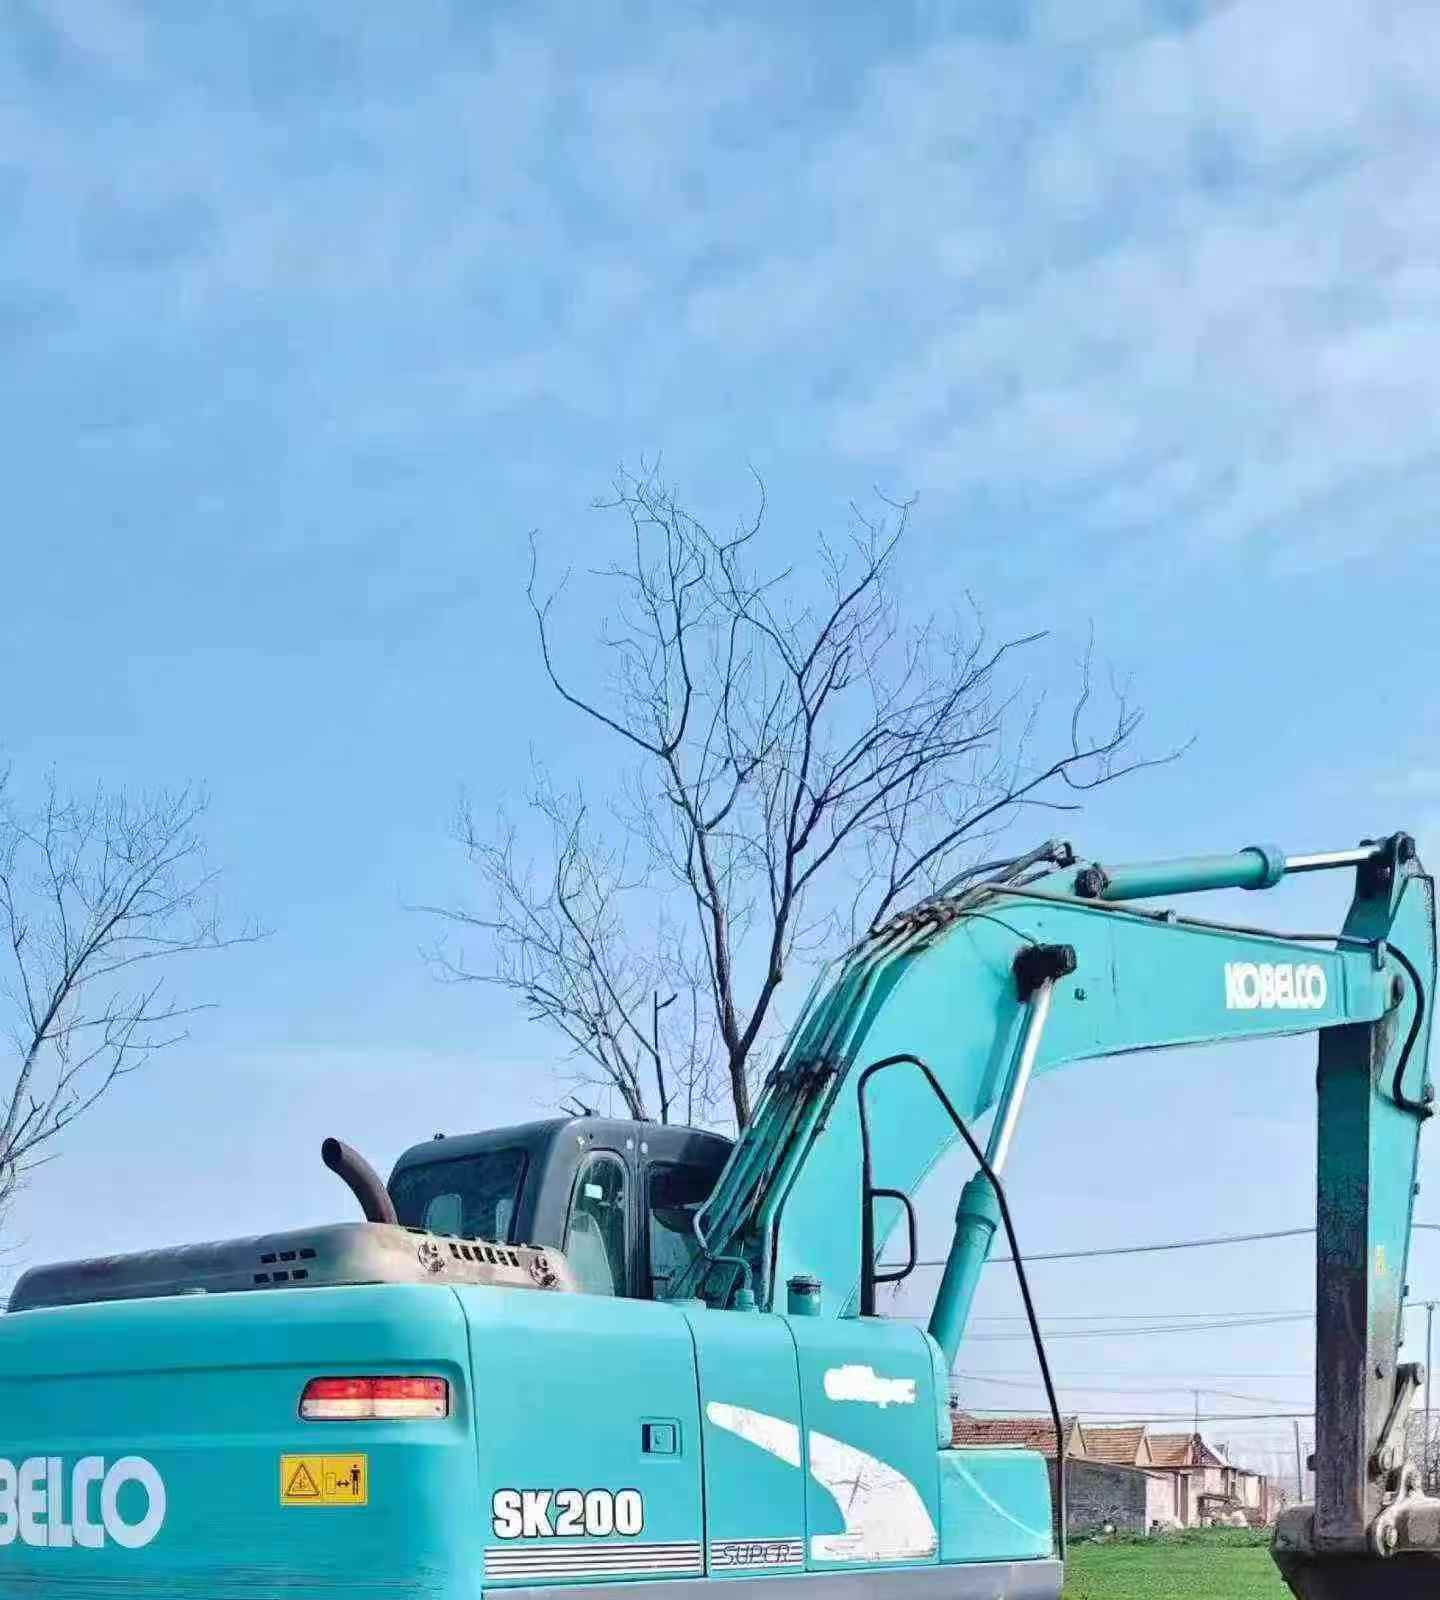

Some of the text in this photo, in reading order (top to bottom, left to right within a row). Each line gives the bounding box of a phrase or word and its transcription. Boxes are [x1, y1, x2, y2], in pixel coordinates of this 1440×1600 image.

[1224, 962, 1327, 1009] KOBELCO
[492, 1487, 644, 1540] SK200
[723, 1544, 790, 1565] SUPER
